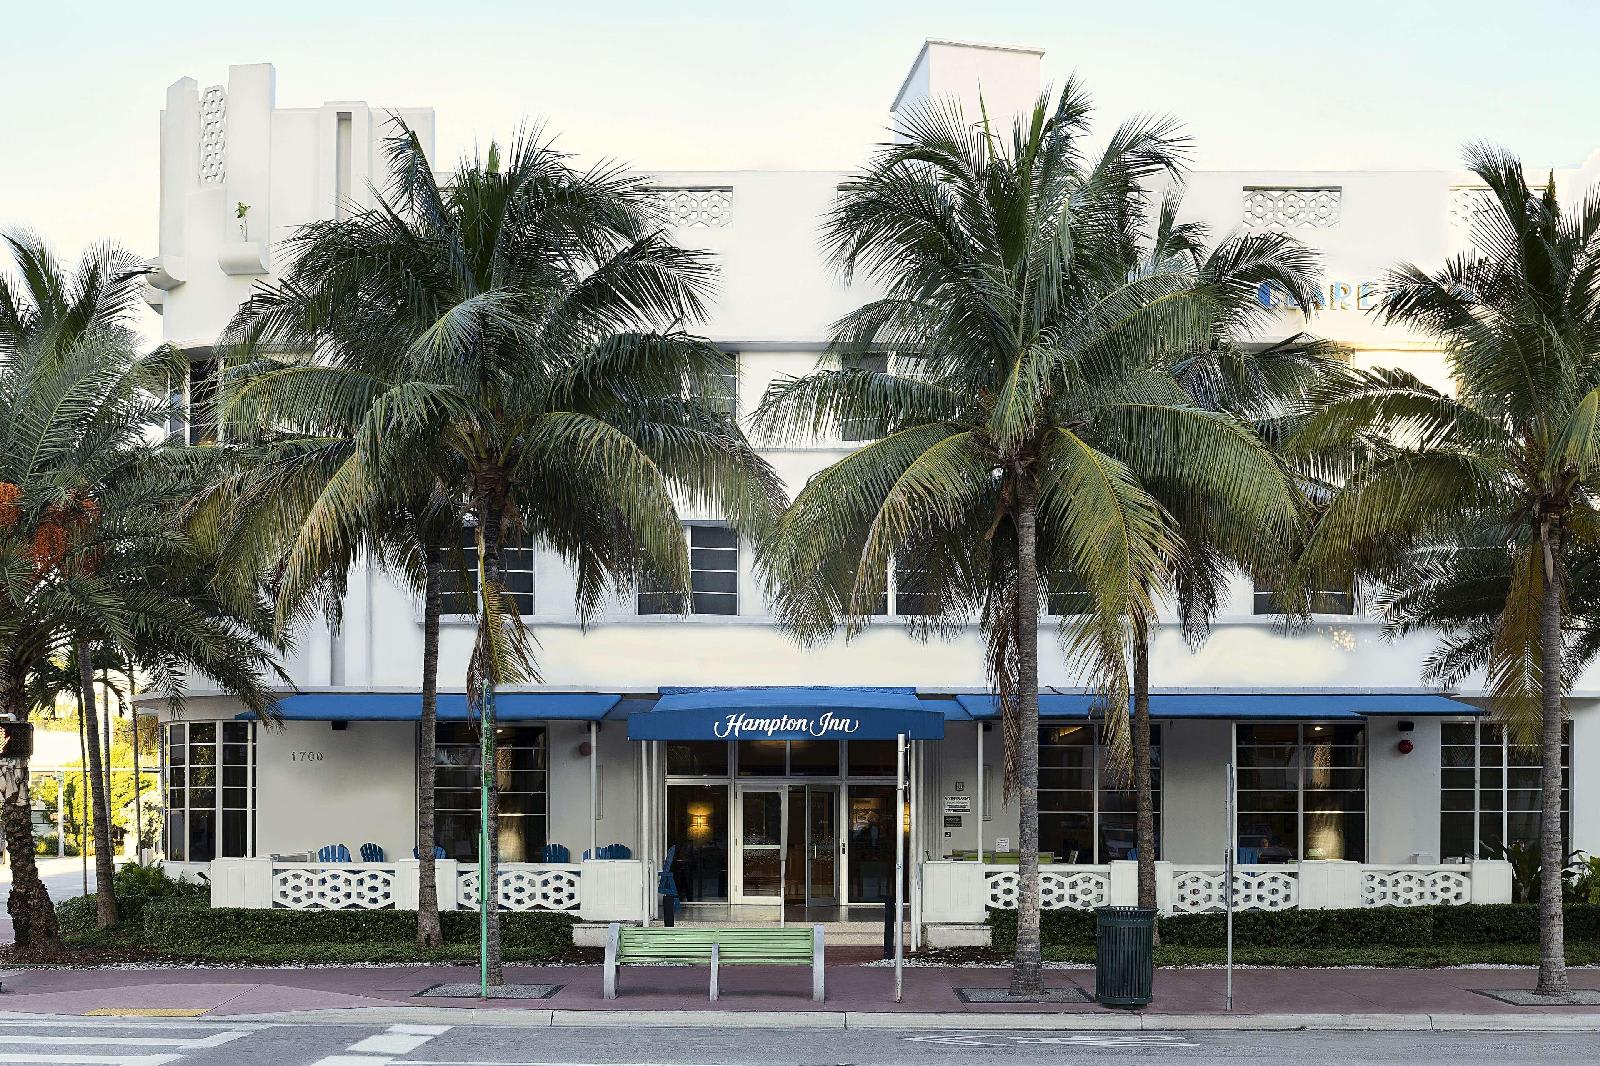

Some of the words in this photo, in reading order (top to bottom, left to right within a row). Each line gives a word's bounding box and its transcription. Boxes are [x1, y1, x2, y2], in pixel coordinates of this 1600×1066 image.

[714, 713, 808, 738] Hampton
[809, 712, 859, 737] Inn
[291, 751, 324, 761] 1700
